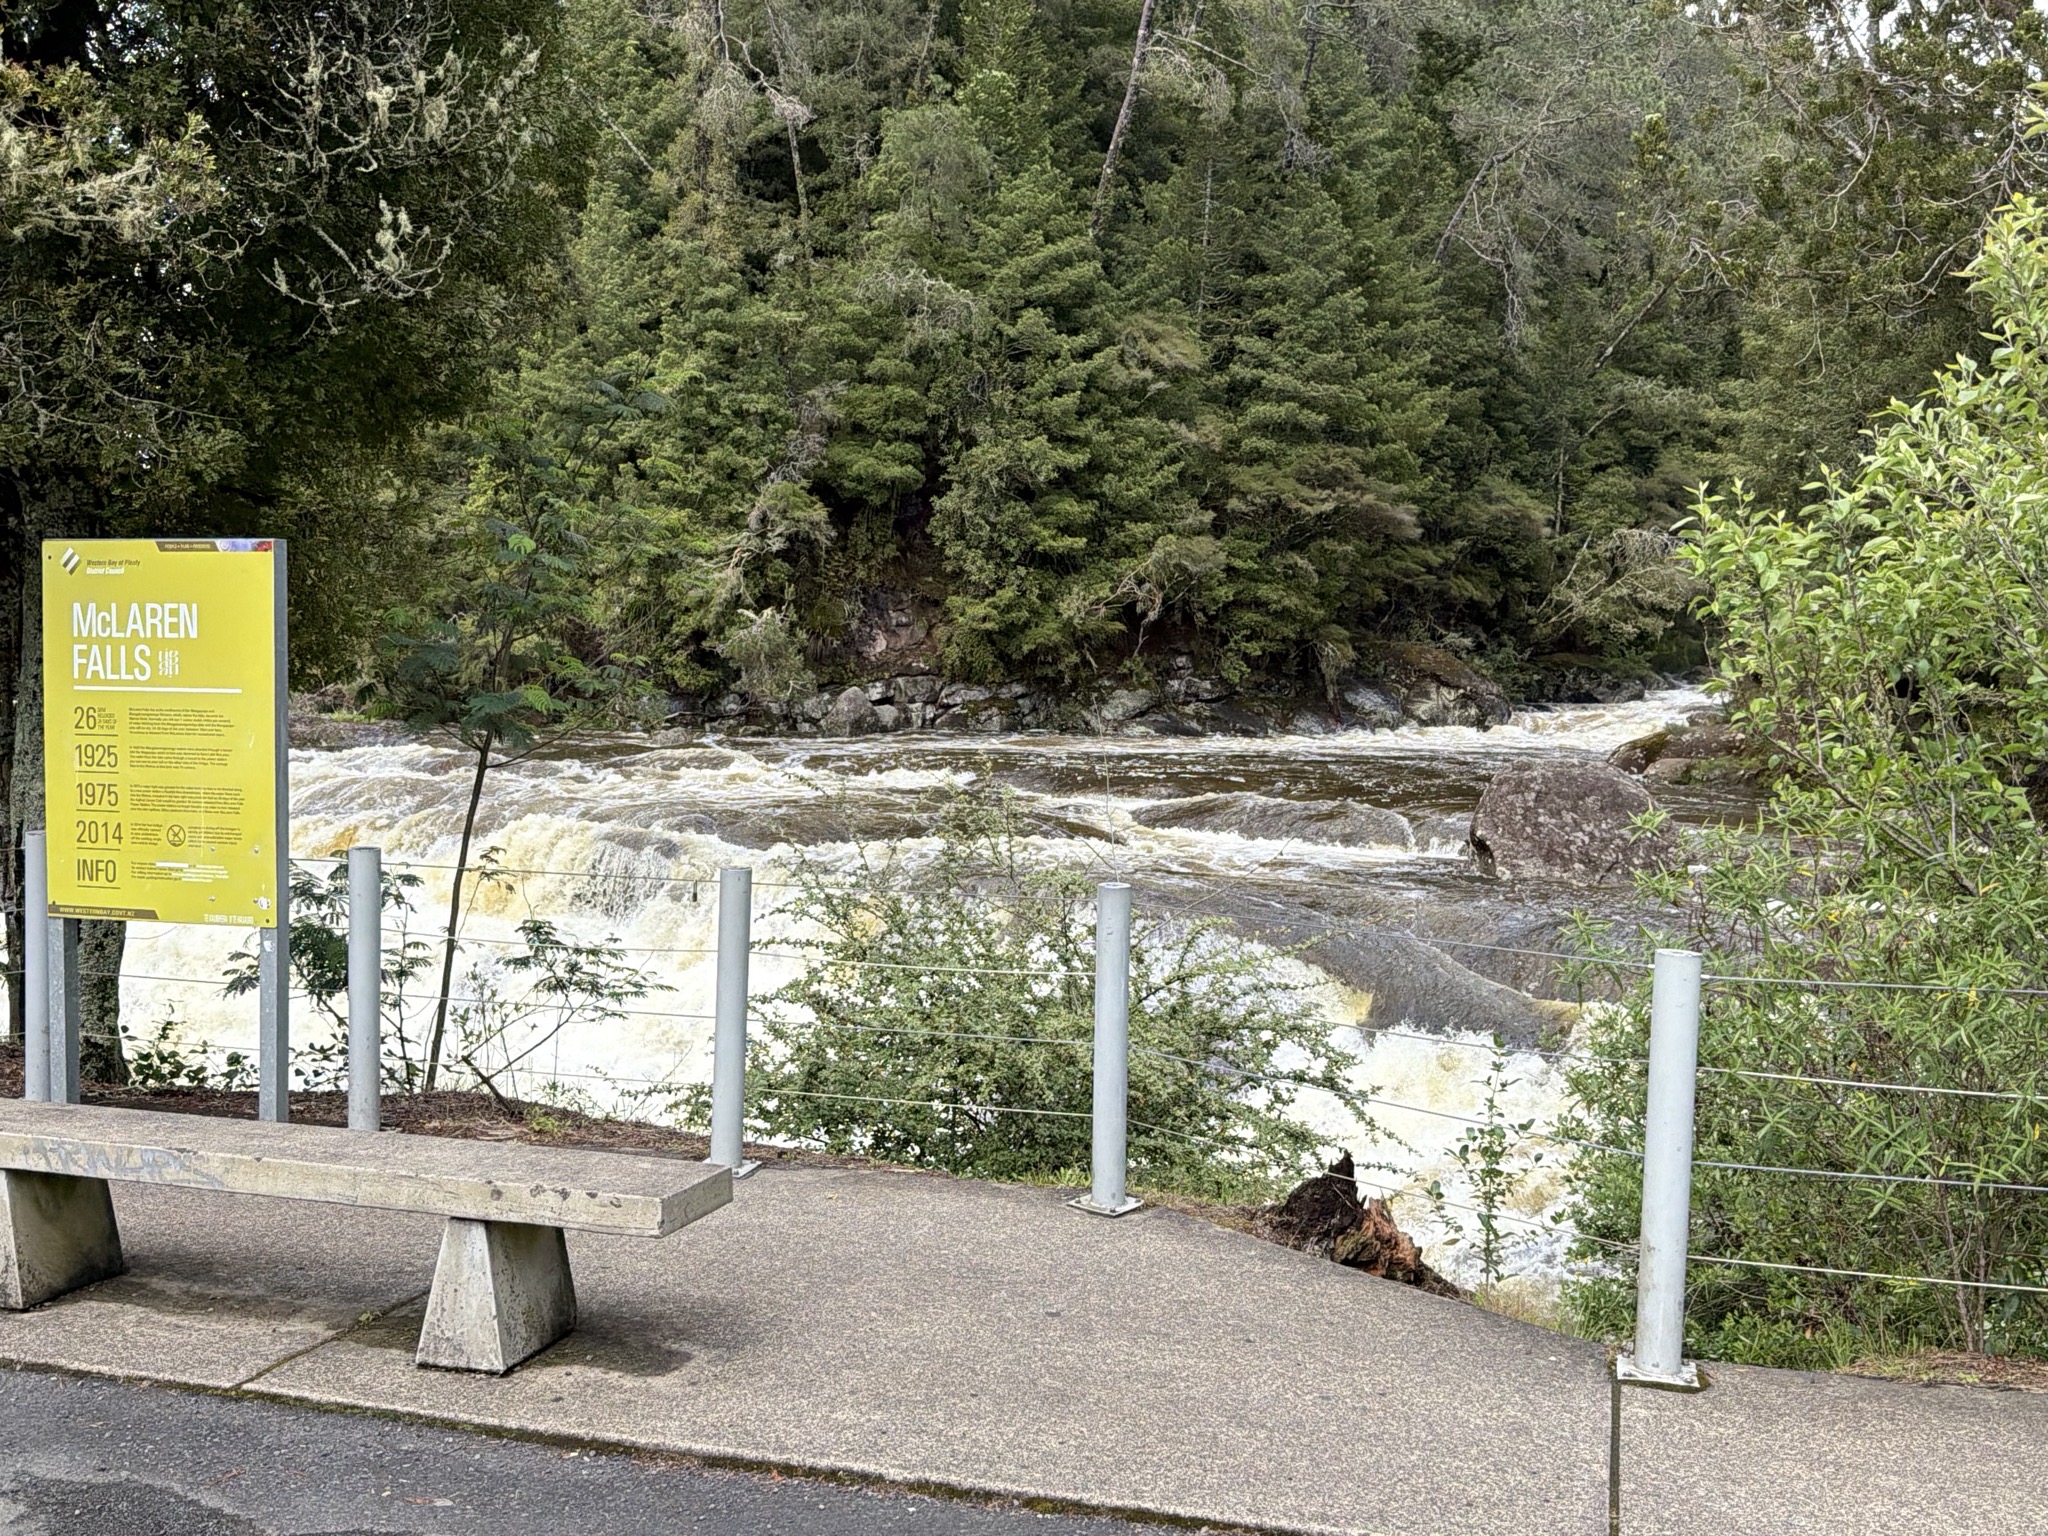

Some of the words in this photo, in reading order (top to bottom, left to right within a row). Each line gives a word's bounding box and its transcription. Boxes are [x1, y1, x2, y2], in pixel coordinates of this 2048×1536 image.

[108, 559, 118, 567] Bay
[124, 559, 141, 567] Plenty
[72, 602, 198, 639] McLAREN
[73, 644, 151, 681] FALLS
[74, 705, 97, 730] 26
[75, 743, 118, 769] 1925
[76, 782, 119, 807] 1975
[76, 820, 124, 845] 2014
[77, 858, 117, 883] INFO
